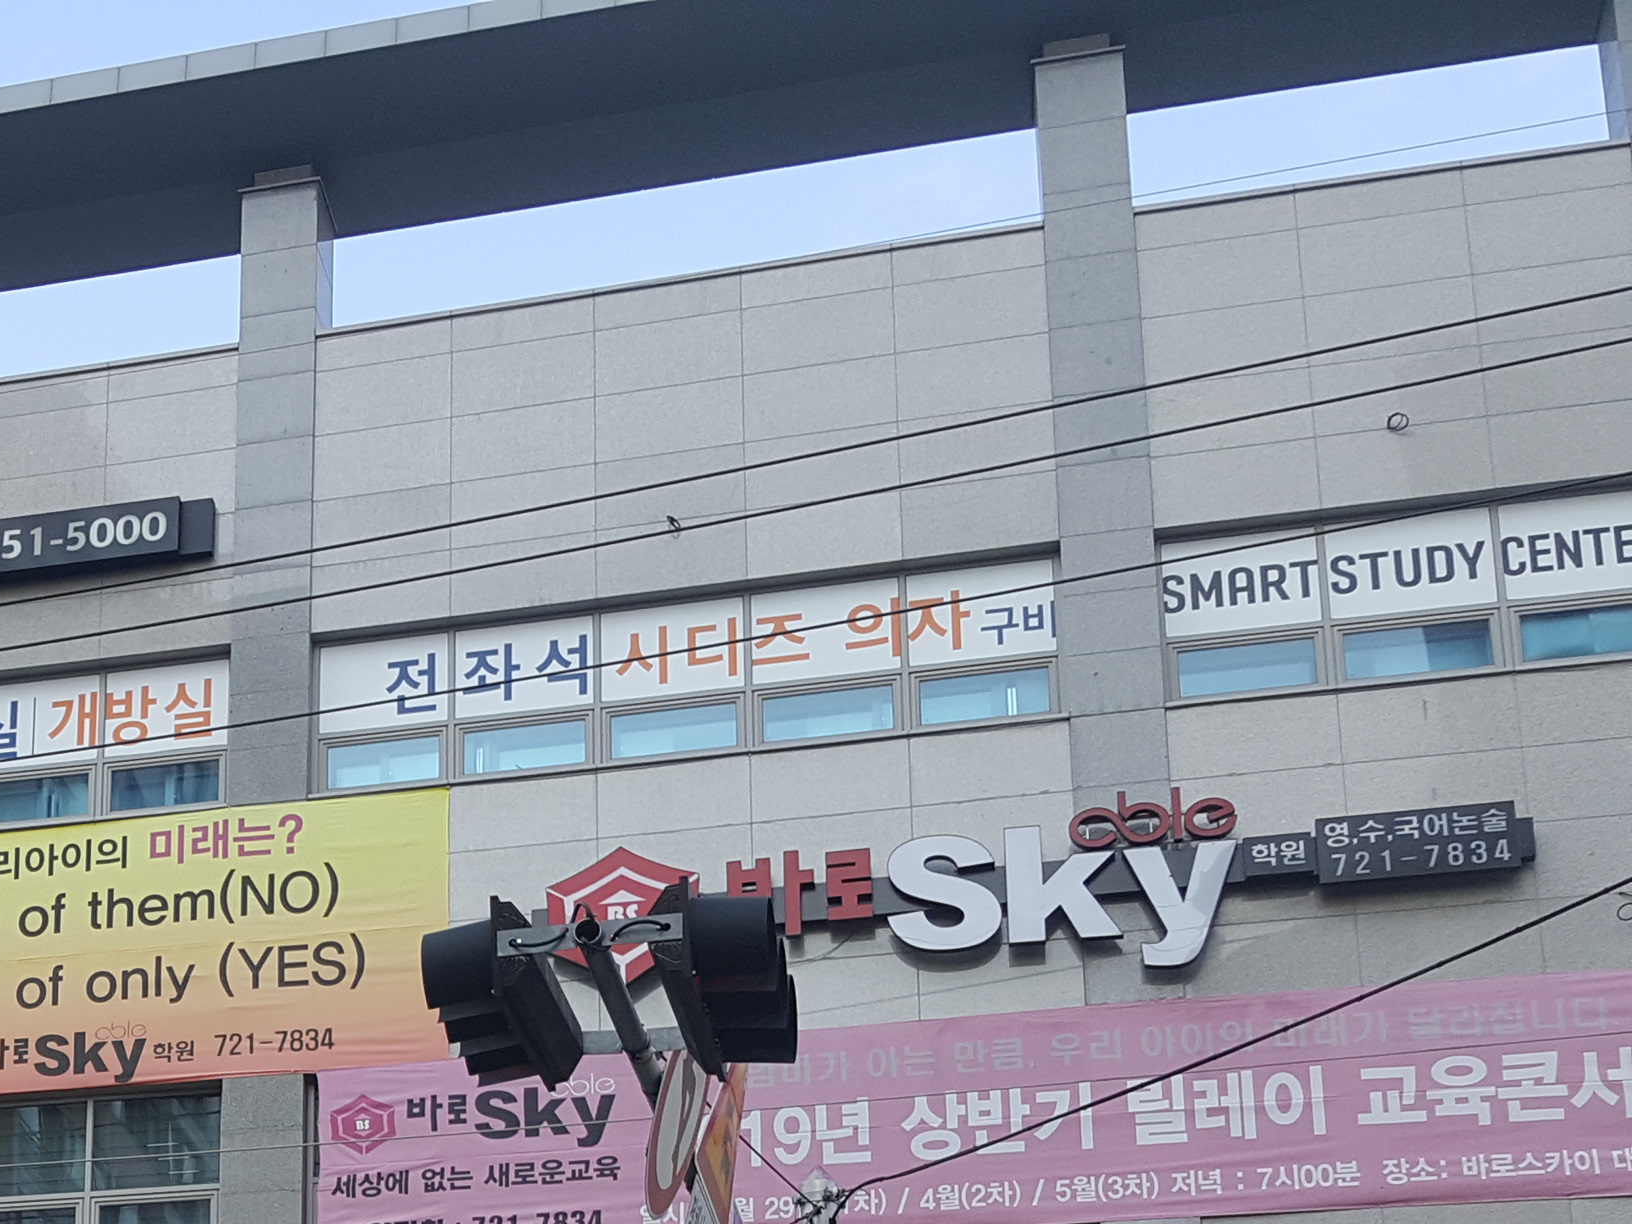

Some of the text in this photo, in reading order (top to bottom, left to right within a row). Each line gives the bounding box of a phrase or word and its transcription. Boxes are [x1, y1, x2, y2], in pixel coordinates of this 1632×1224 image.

[1163, 558, 1318, 614] SMART
[1329, 540, 1486, 595] STUDY
[386, 589, 1055, 715] 전좌석 시디즈 의자 구비
[48, 677, 214, 748] 개방실
[149, 813, 305, 865] 미래는?
[1330, 839, 1513, 877] 721-7834
[18, 892, 66, 938] of
[88, 861, 340, 932] them(NO)
[725, 824, 1308, 969] 바로 Sky 학원
[15, 964, 64, 1010] of
[85, 956, 196, 1004] only
[218, 933, 366, 999] (YES)
[34, 1031, 148, 1083] Sky
[152, 1040, 196, 1063] 학원
[213, 1026, 336, 1058] 721-7834
[1049, 1028, 1123, 1067] 우리
[406, 1086, 617, 1148] 바로 Sky
[900, 1081, 1094, 1162] 상반기
[1126, 1064, 1327, 1146] 릴레이
[330, 1155, 621, 1200] 세상에 없는 새로운교육
[919, 1181, 1021, 1213] 4월(2차)
[1054, 1173, 1160, 1203] 5월(3차)
[1170, 1168, 1223, 1197] 저녁
[1256, 1160, 1361, 1191] 7시00분
[1461, 1148, 1602, 1180] 바로스카이
